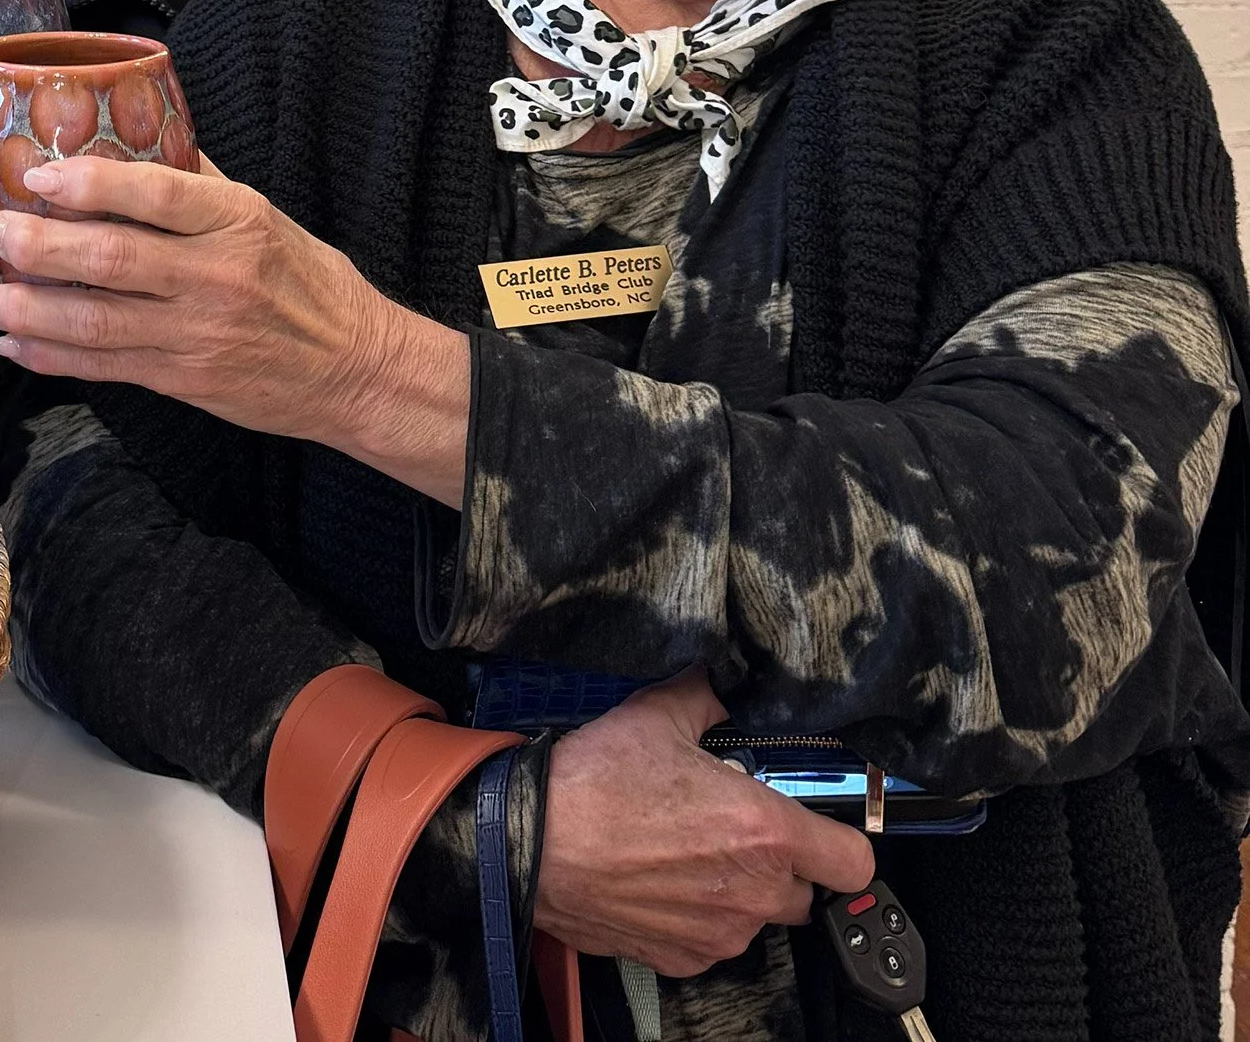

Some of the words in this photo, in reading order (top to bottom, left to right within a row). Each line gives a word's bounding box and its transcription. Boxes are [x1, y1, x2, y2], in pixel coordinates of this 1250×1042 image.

[496, 265, 570, 287] Carlette
[579, 259, 597, 278] B.
[604, 255, 661, 275] Peters
[516, 286, 554, 301] Triad
[562, 281, 609, 297] Bridge
[617, 275, 653, 290] Club
[528, 296, 621, 315] Greensboro,
[627, 291, 652, 304] NC
